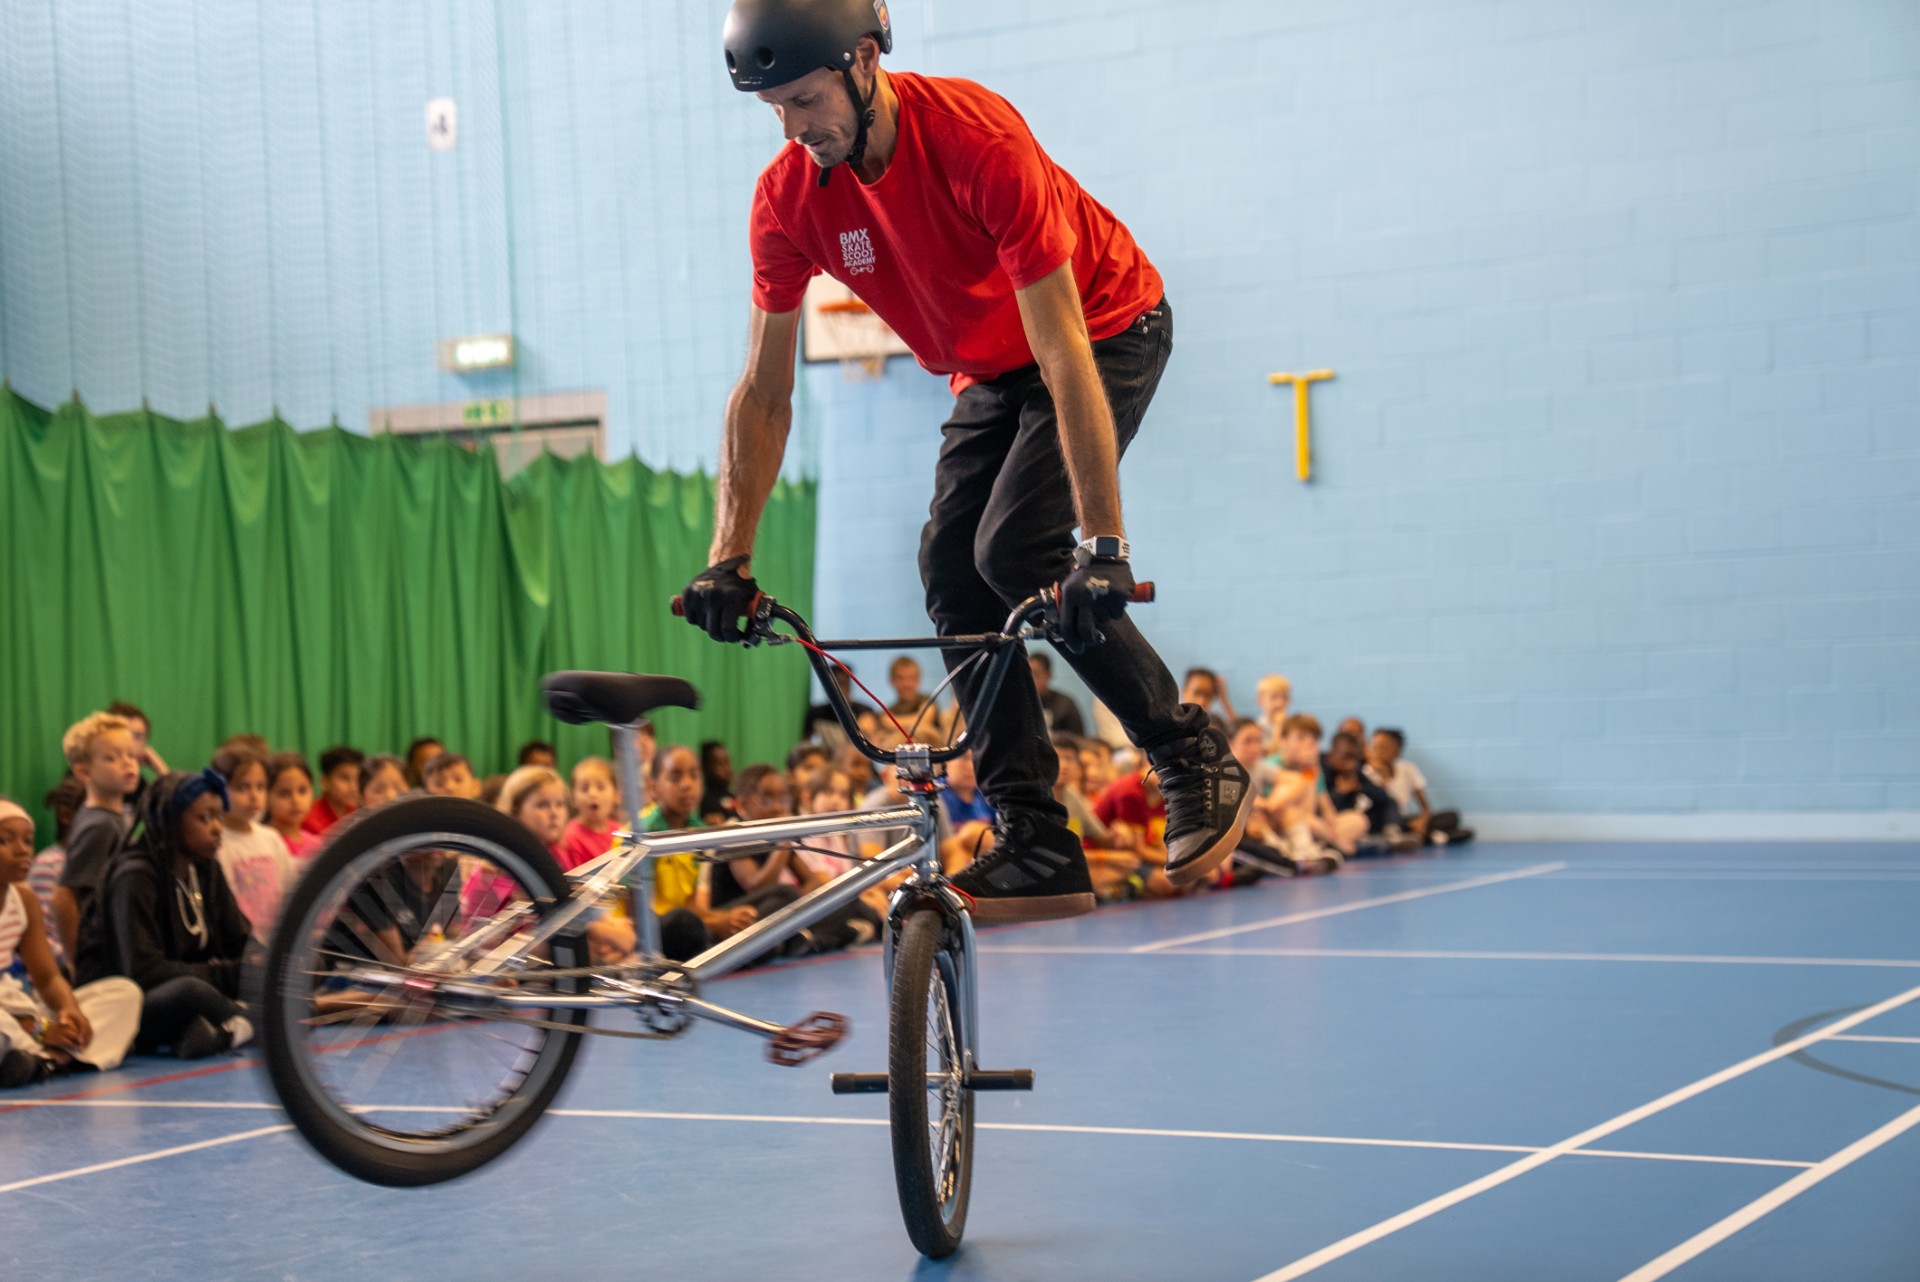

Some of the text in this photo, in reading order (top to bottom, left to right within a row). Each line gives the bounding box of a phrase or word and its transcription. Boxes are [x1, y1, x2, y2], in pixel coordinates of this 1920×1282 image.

[840, 228, 869, 245] BMX
[842, 240, 874, 253] SKATE
[843, 248, 875, 261] SCOOT
[844, 256, 876, 268] ACADEMY
